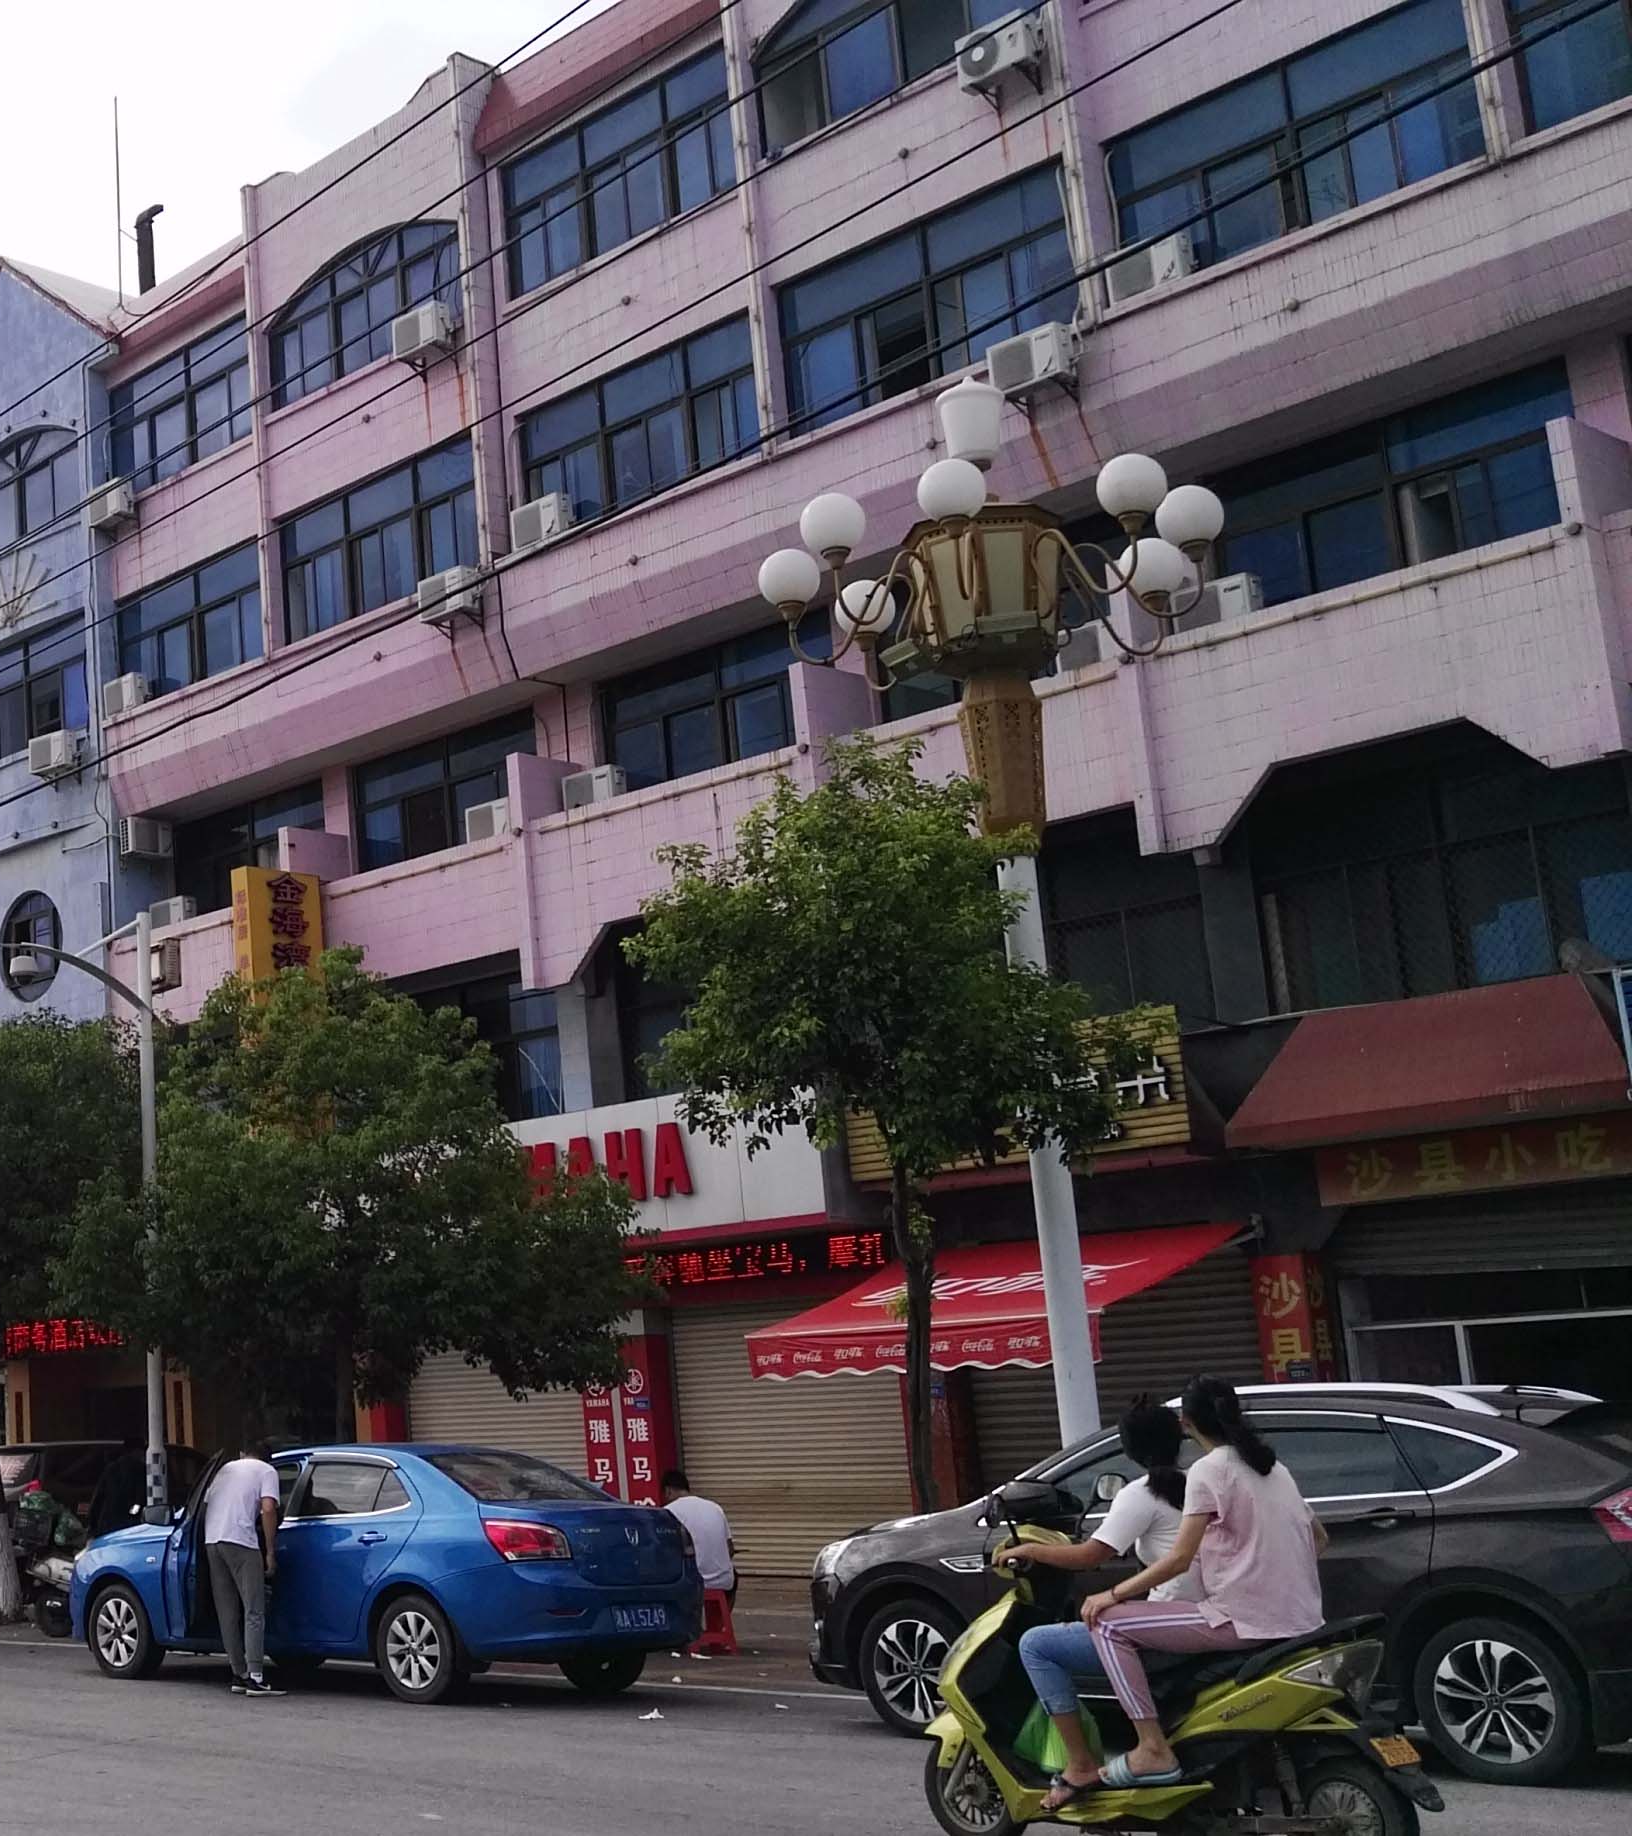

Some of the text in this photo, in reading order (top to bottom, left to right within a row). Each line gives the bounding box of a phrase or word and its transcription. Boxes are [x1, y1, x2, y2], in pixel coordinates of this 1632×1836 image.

[1345, 1121, 1613, 1200] 沙县小吃
[1259, 1271, 1312, 1373] 沙县
[585, 1398, 611, 1408] YAMAHA
